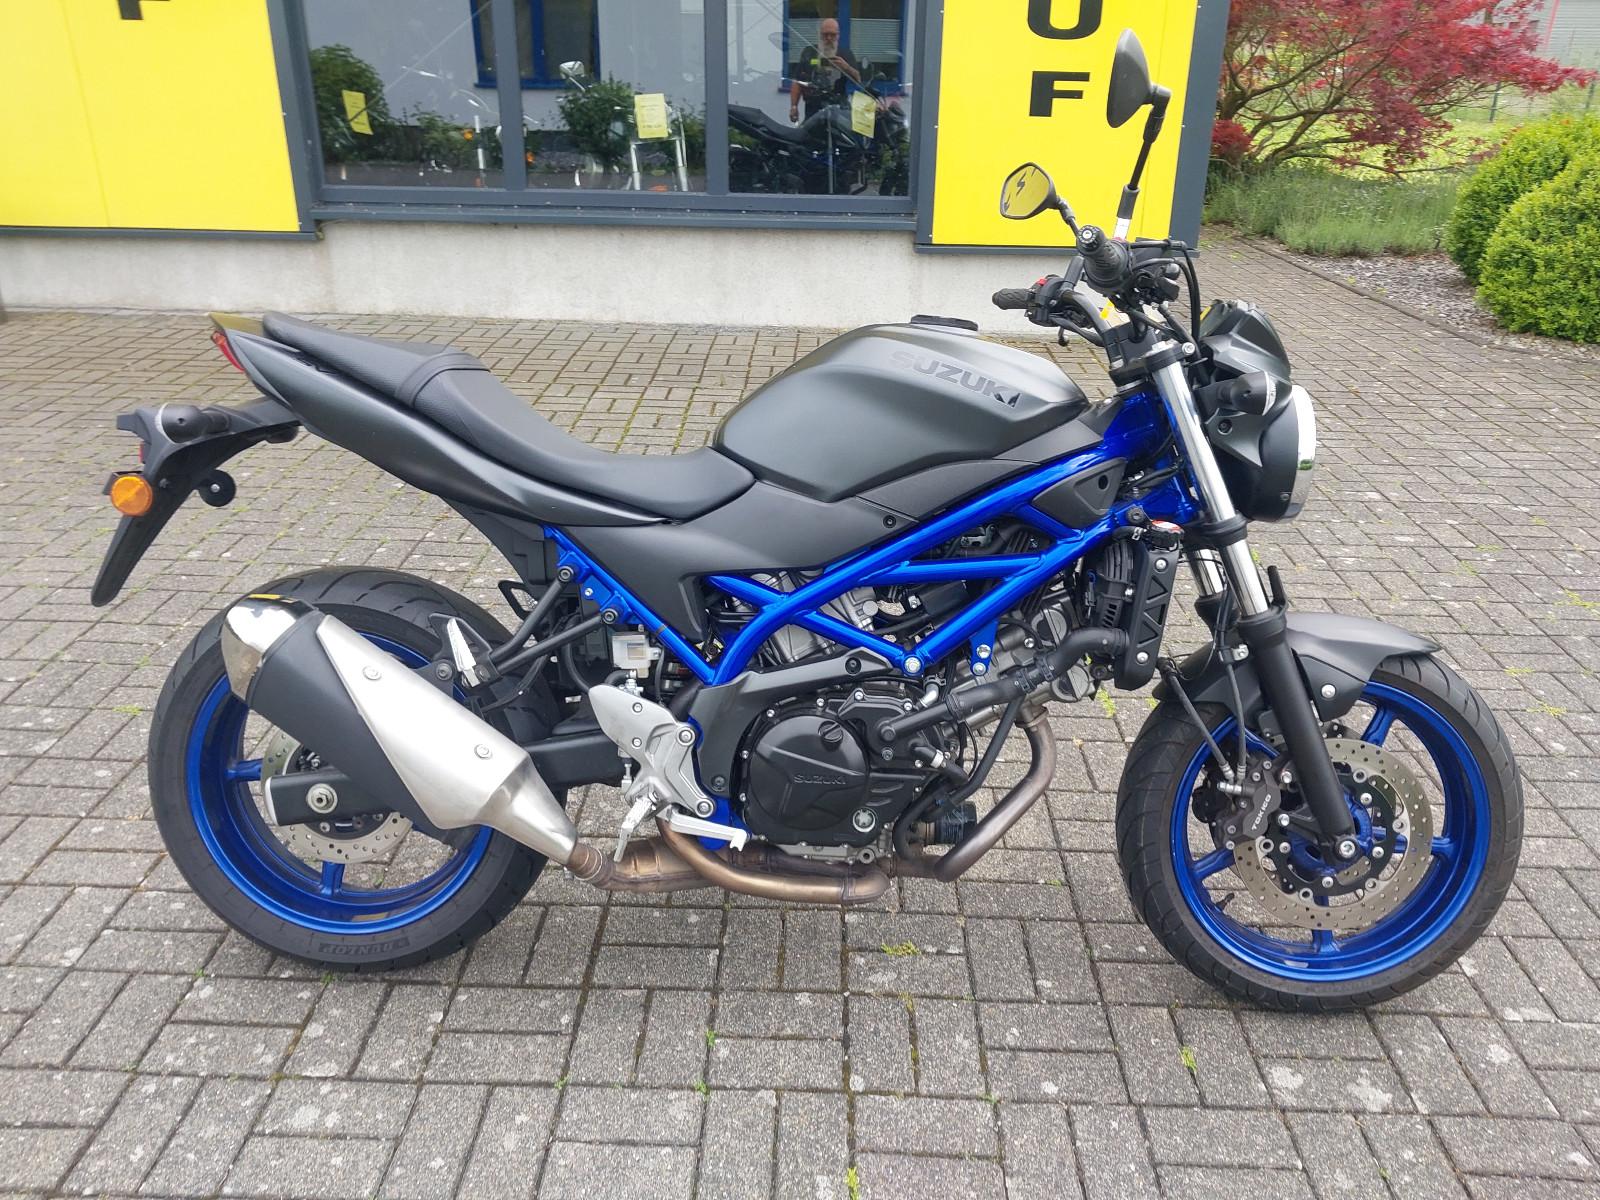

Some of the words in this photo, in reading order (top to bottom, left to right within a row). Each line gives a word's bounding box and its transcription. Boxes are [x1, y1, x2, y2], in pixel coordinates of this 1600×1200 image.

[889, 350, 1021, 408] SUZUKI
[793, 774, 846, 785] SUZUKI
[1251, 793, 1272, 831] TOKICO
[321, 942, 394, 956] DUNLOP
